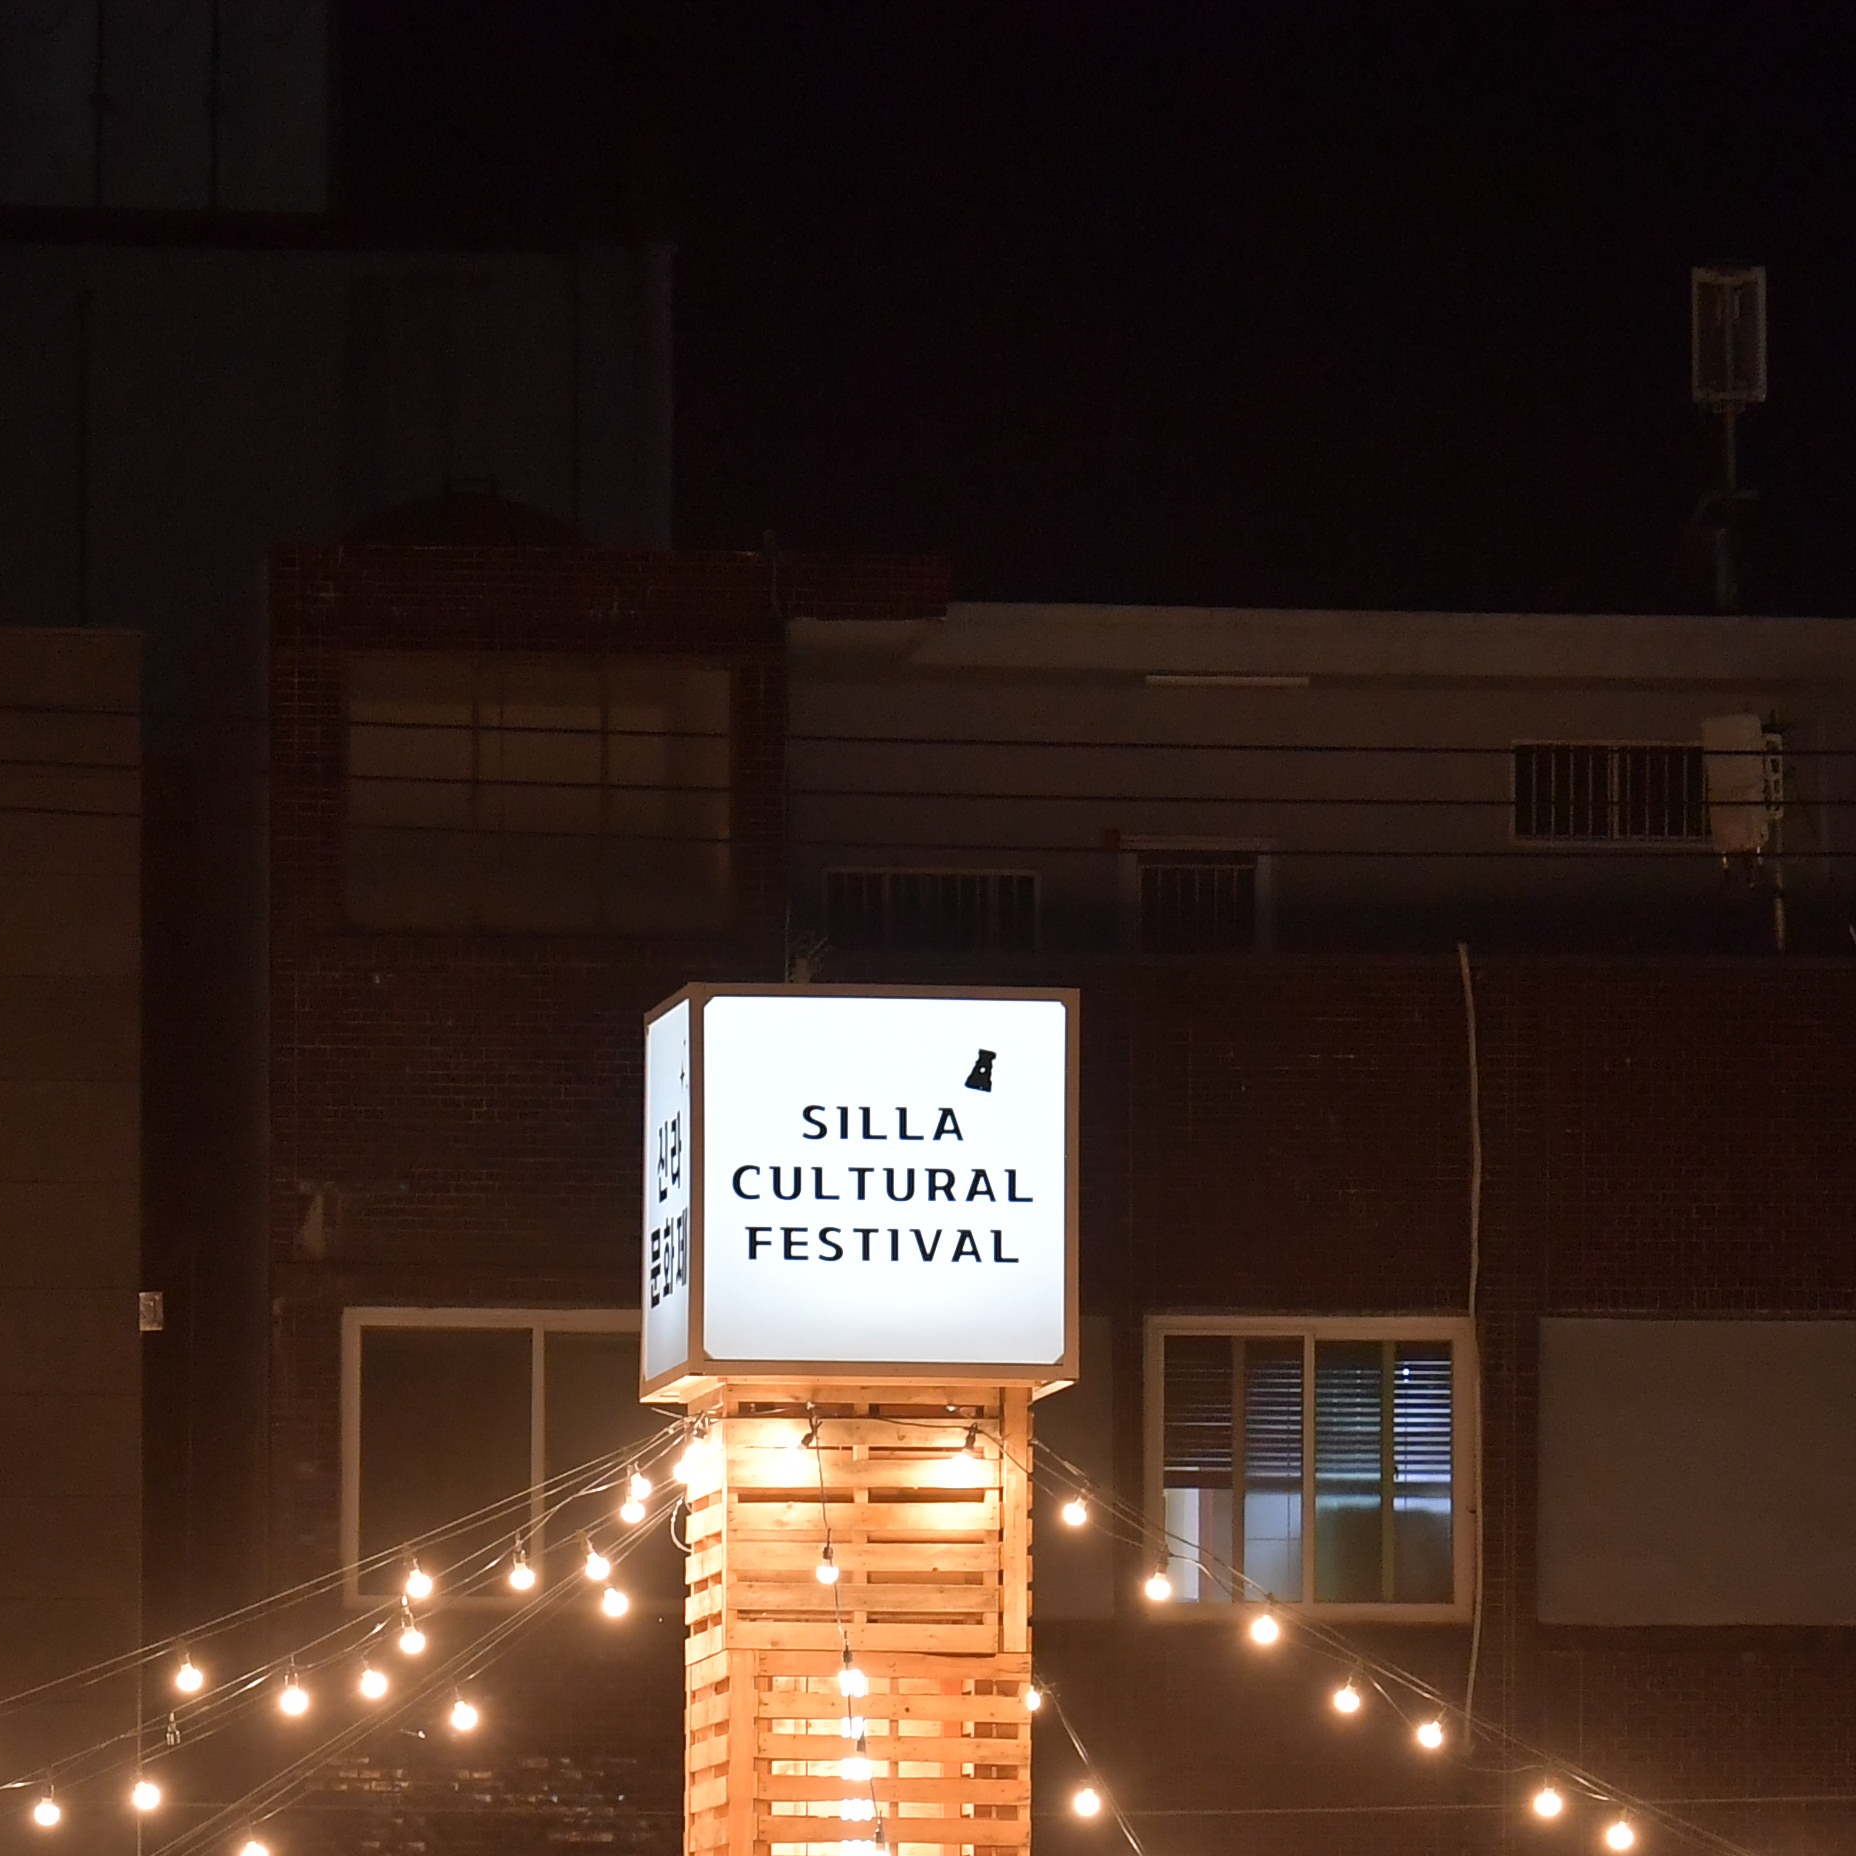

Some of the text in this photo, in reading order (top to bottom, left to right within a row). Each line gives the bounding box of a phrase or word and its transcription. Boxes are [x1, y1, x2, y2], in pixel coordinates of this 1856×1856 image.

[802, 1105, 964, 1141] SILLA
[656, 1110, 684, 1204] 신라
[732, 1164, 1034, 1203] CULTURAL
[649, 1206, 689, 1310] 문화제
[745, 1226, 1019, 1263] FESTIVAL
